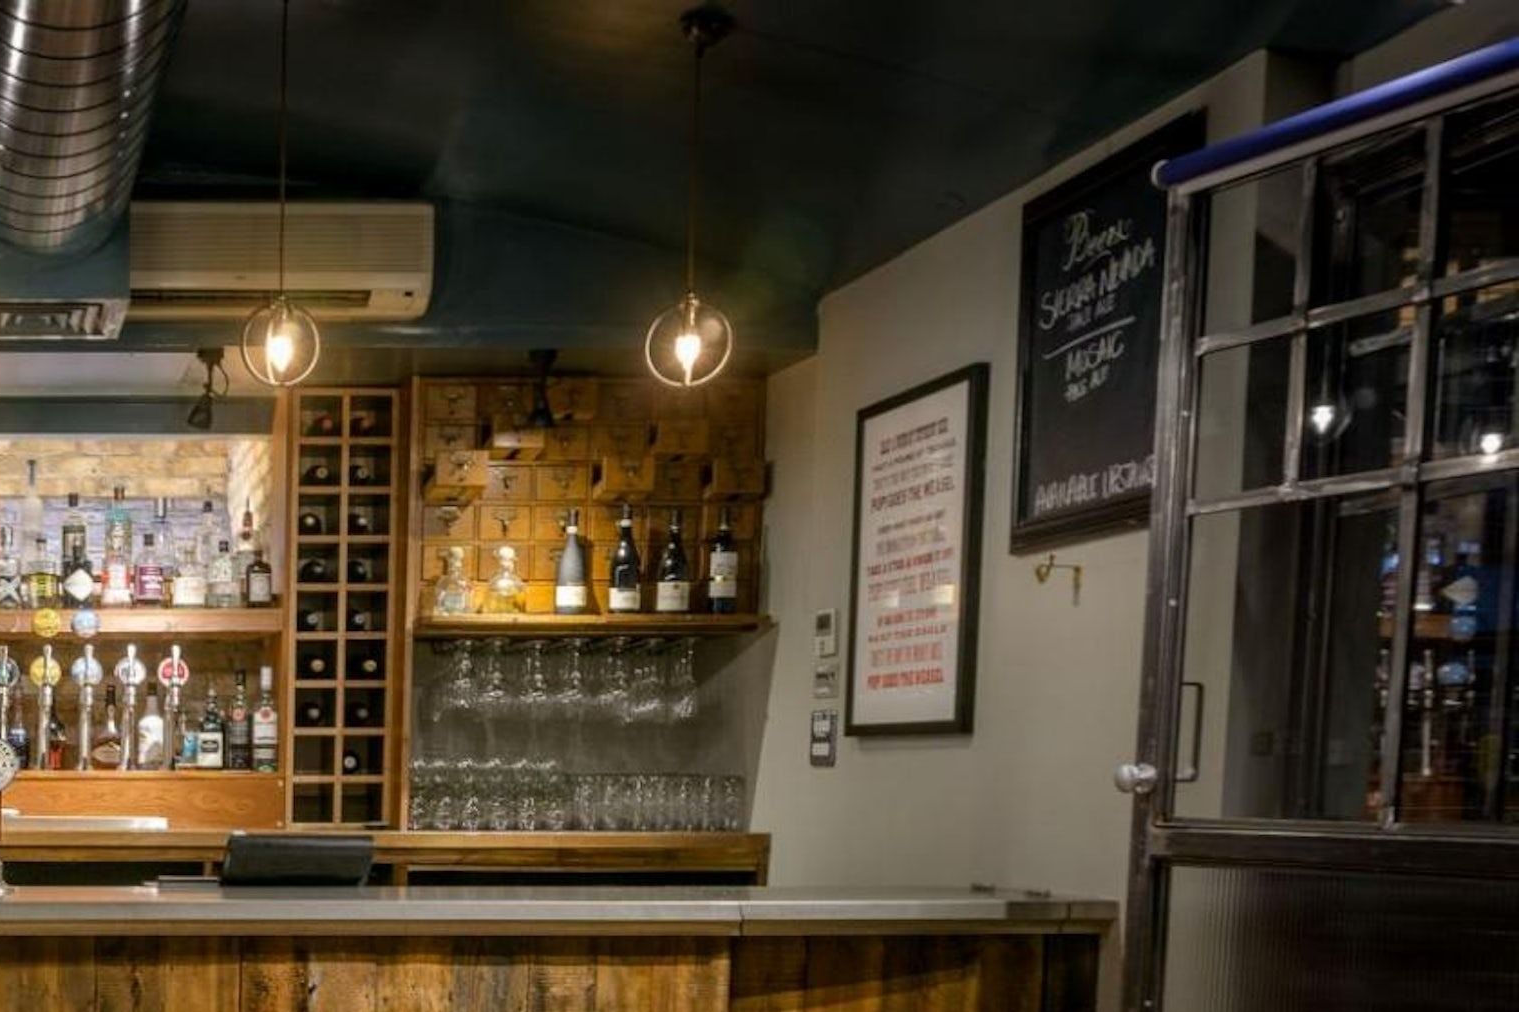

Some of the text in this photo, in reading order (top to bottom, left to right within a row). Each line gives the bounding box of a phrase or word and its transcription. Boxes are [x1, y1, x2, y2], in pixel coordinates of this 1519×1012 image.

[1039, 237, 1155, 330] SIERRA NEVADA
[1094, 293, 1117, 318] ALE
[1064, 329, 1125, 380] MOSAIC
[1033, 470, 1099, 516] AVAILABLE
